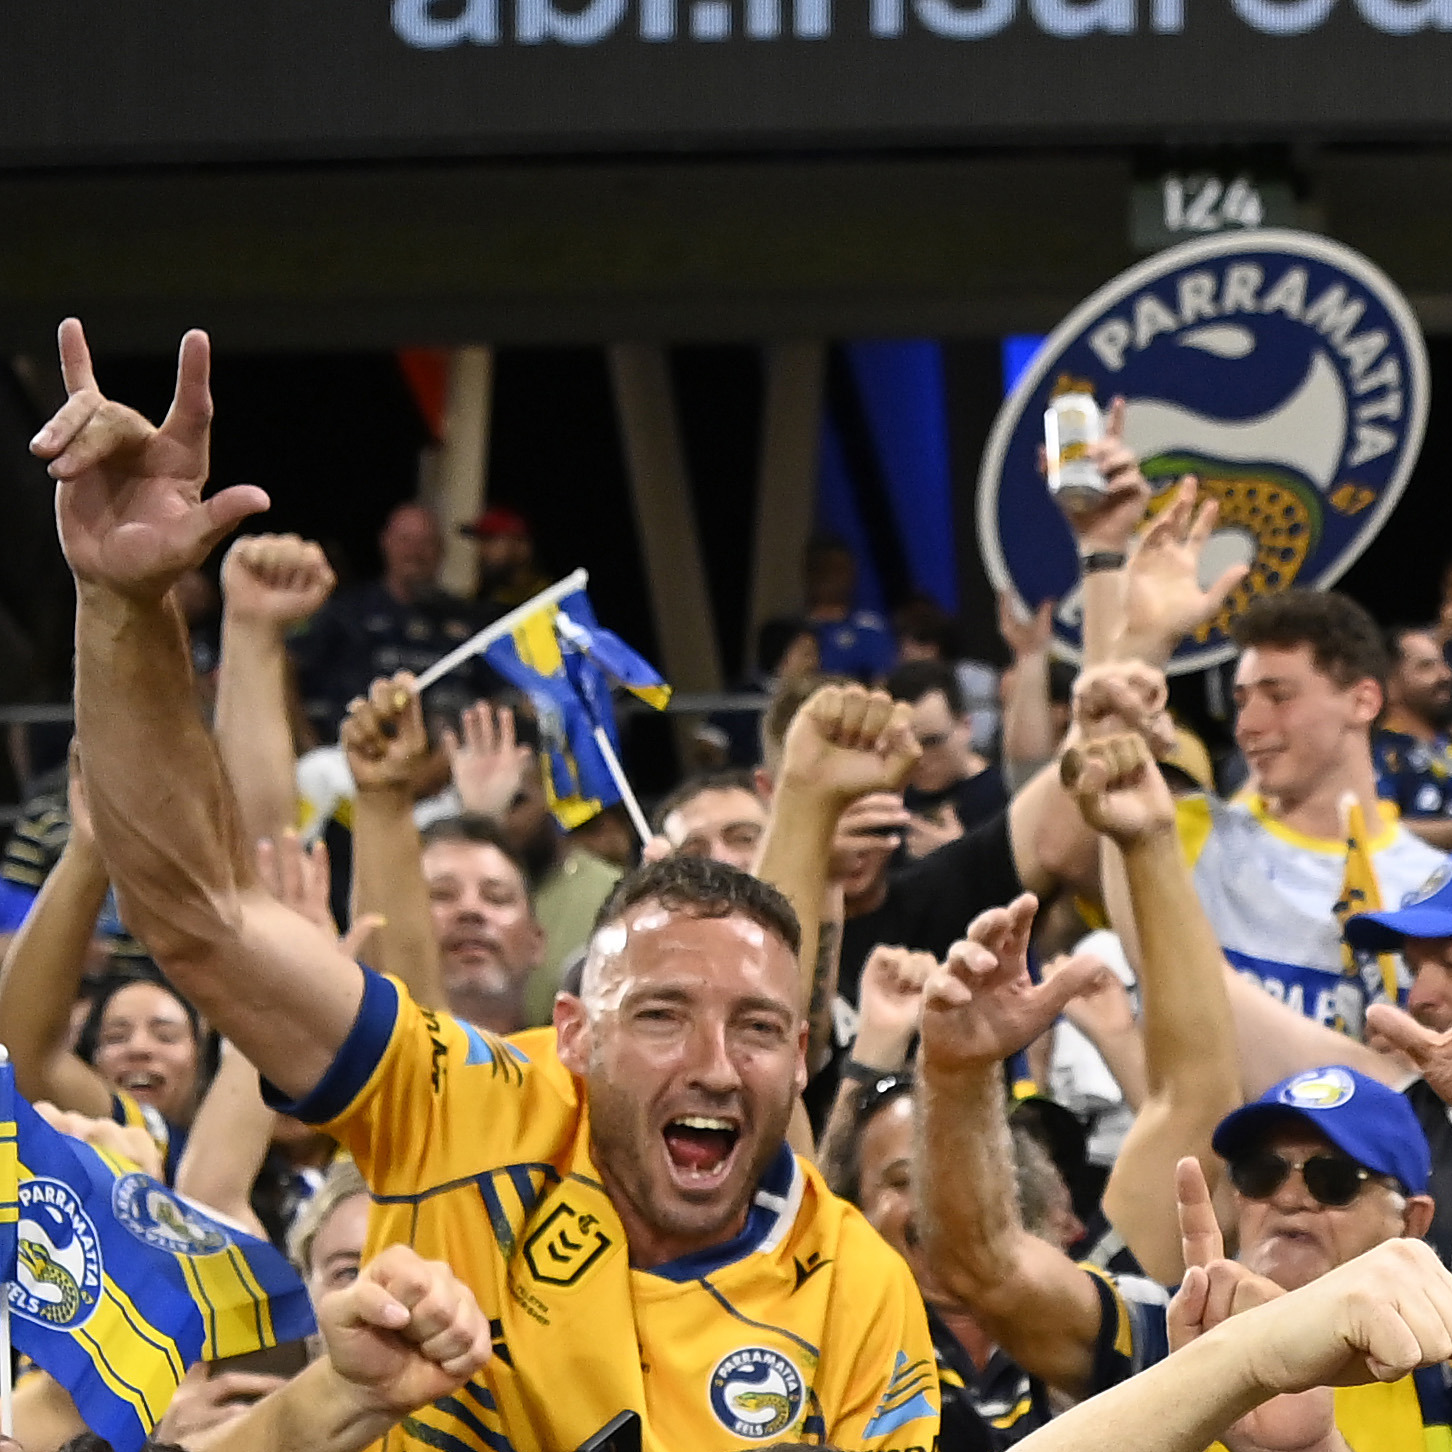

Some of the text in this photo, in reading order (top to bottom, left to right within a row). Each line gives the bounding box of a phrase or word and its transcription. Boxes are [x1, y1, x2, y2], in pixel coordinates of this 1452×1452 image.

[1163, 176, 1263, 232] 124
[1090, 262, 1404, 468] PARRAMATTA
[19, 1184, 99, 1288] PARRAMATTA
[717, 1350, 800, 1393] PARRAMATTA
[734, 1421, 764, 1437] EELS
